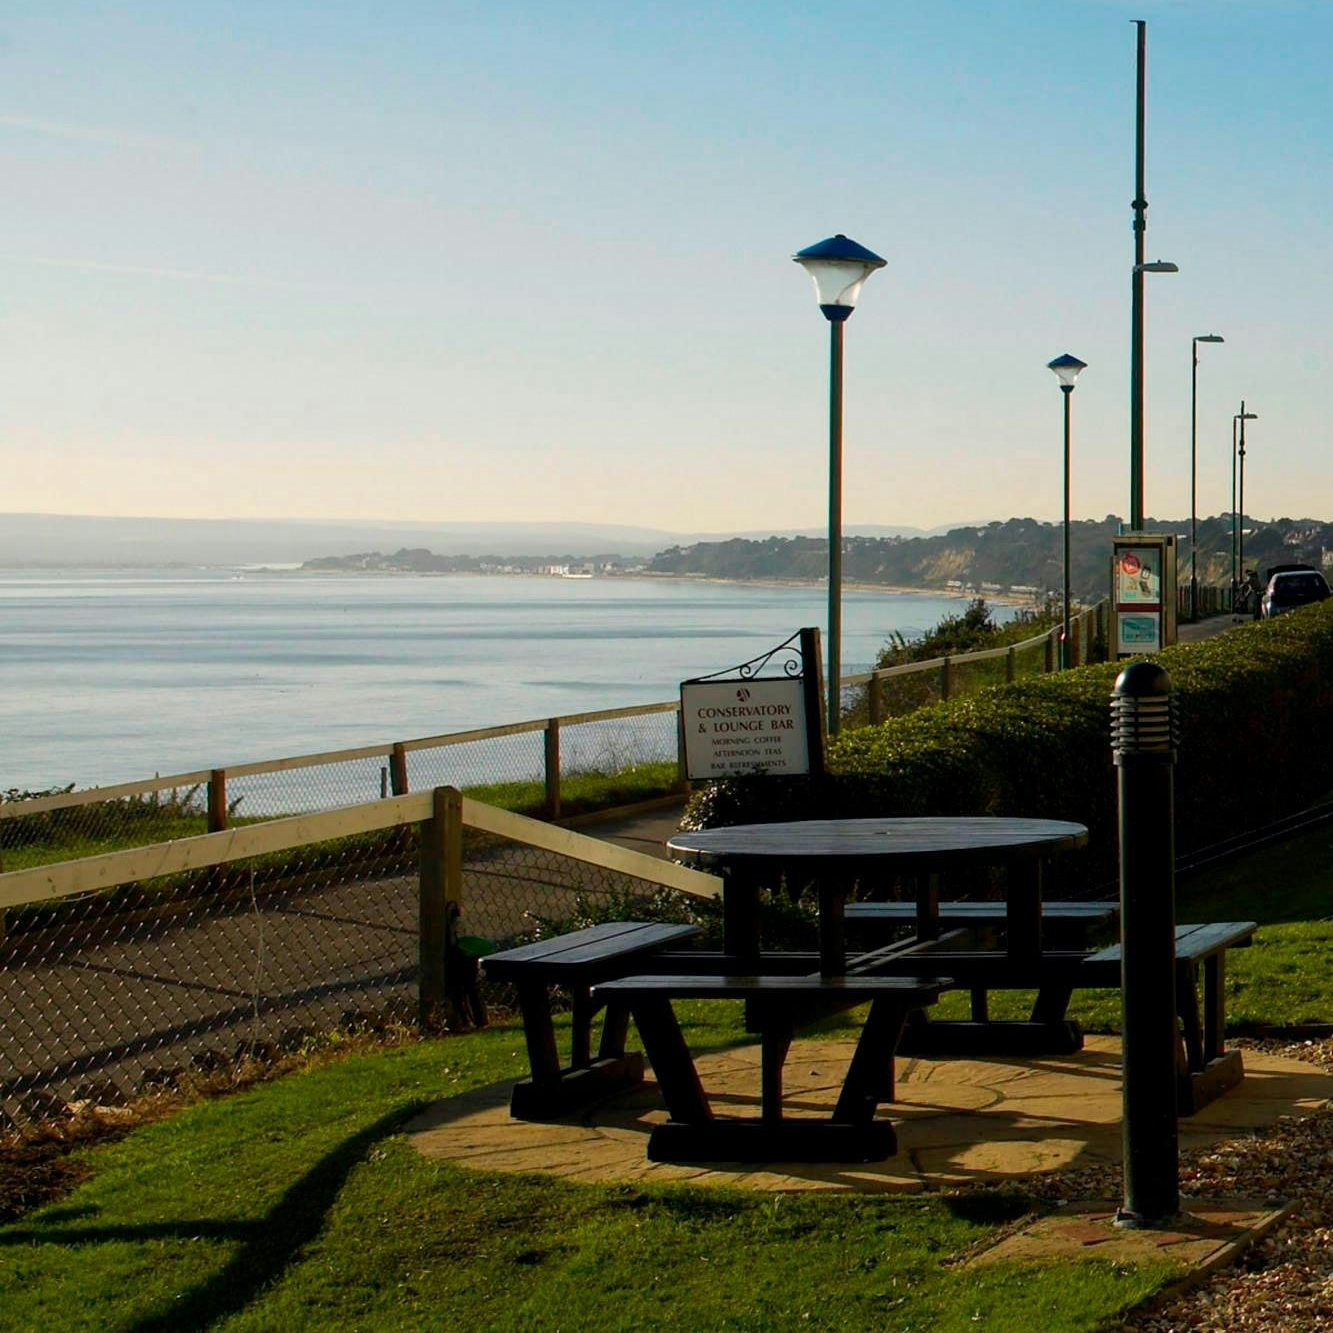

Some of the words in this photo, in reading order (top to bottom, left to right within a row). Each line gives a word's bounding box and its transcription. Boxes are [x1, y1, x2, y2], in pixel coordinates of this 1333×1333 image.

[697, 705, 792, 718] CONSERVATORY
[698, 722, 706, 733] &
[714, 720, 764, 733] LOUNGE
[771, 719, 794, 730] BAR
[712, 737, 750, 746] MORNING
[753, 736, 782, 744] COFFEE
[713, 749, 760, 757] AFTERNOON
[764, 747, 782, 755] TEAS
